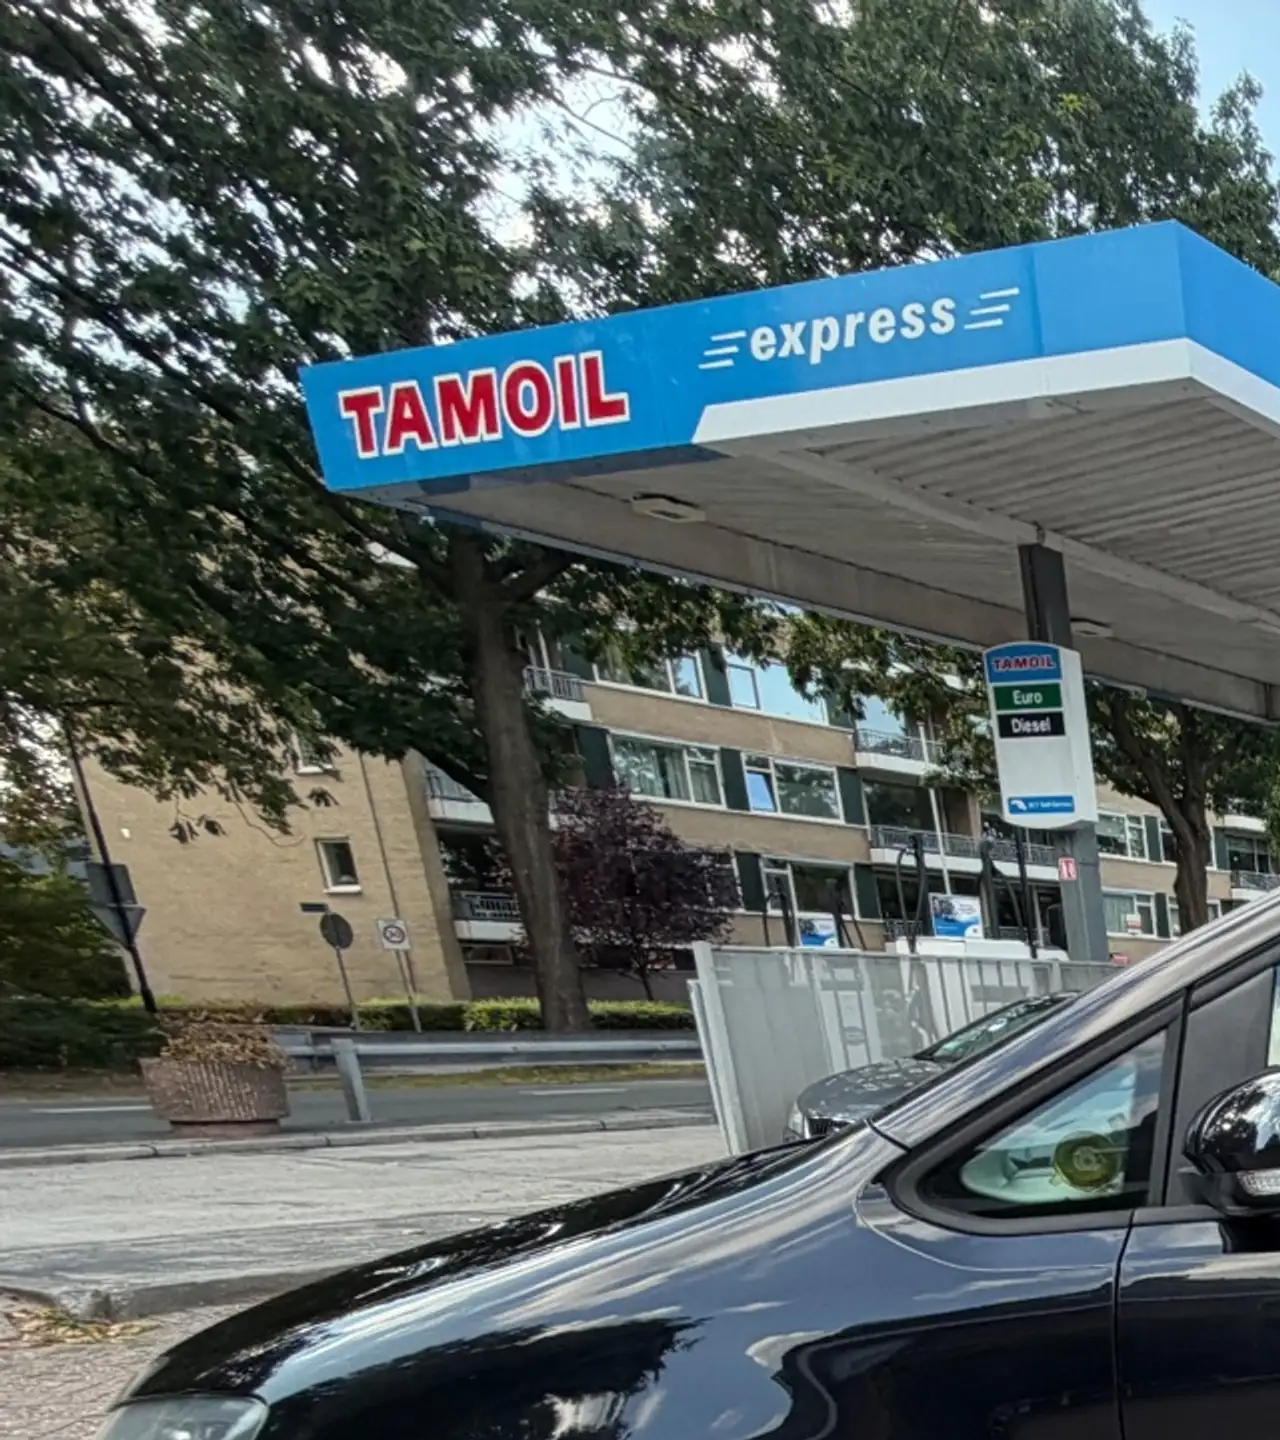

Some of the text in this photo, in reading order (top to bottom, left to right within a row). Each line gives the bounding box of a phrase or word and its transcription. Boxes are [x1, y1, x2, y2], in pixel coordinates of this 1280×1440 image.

[750, 296, 956, 365] express
[338, 350, 630, 458] TAMOIL
[992, 654, 1056, 673] TAMOIL
[1012, 689, 1043, 706] Euro
[1010, 715, 1052, 734] Diesel
